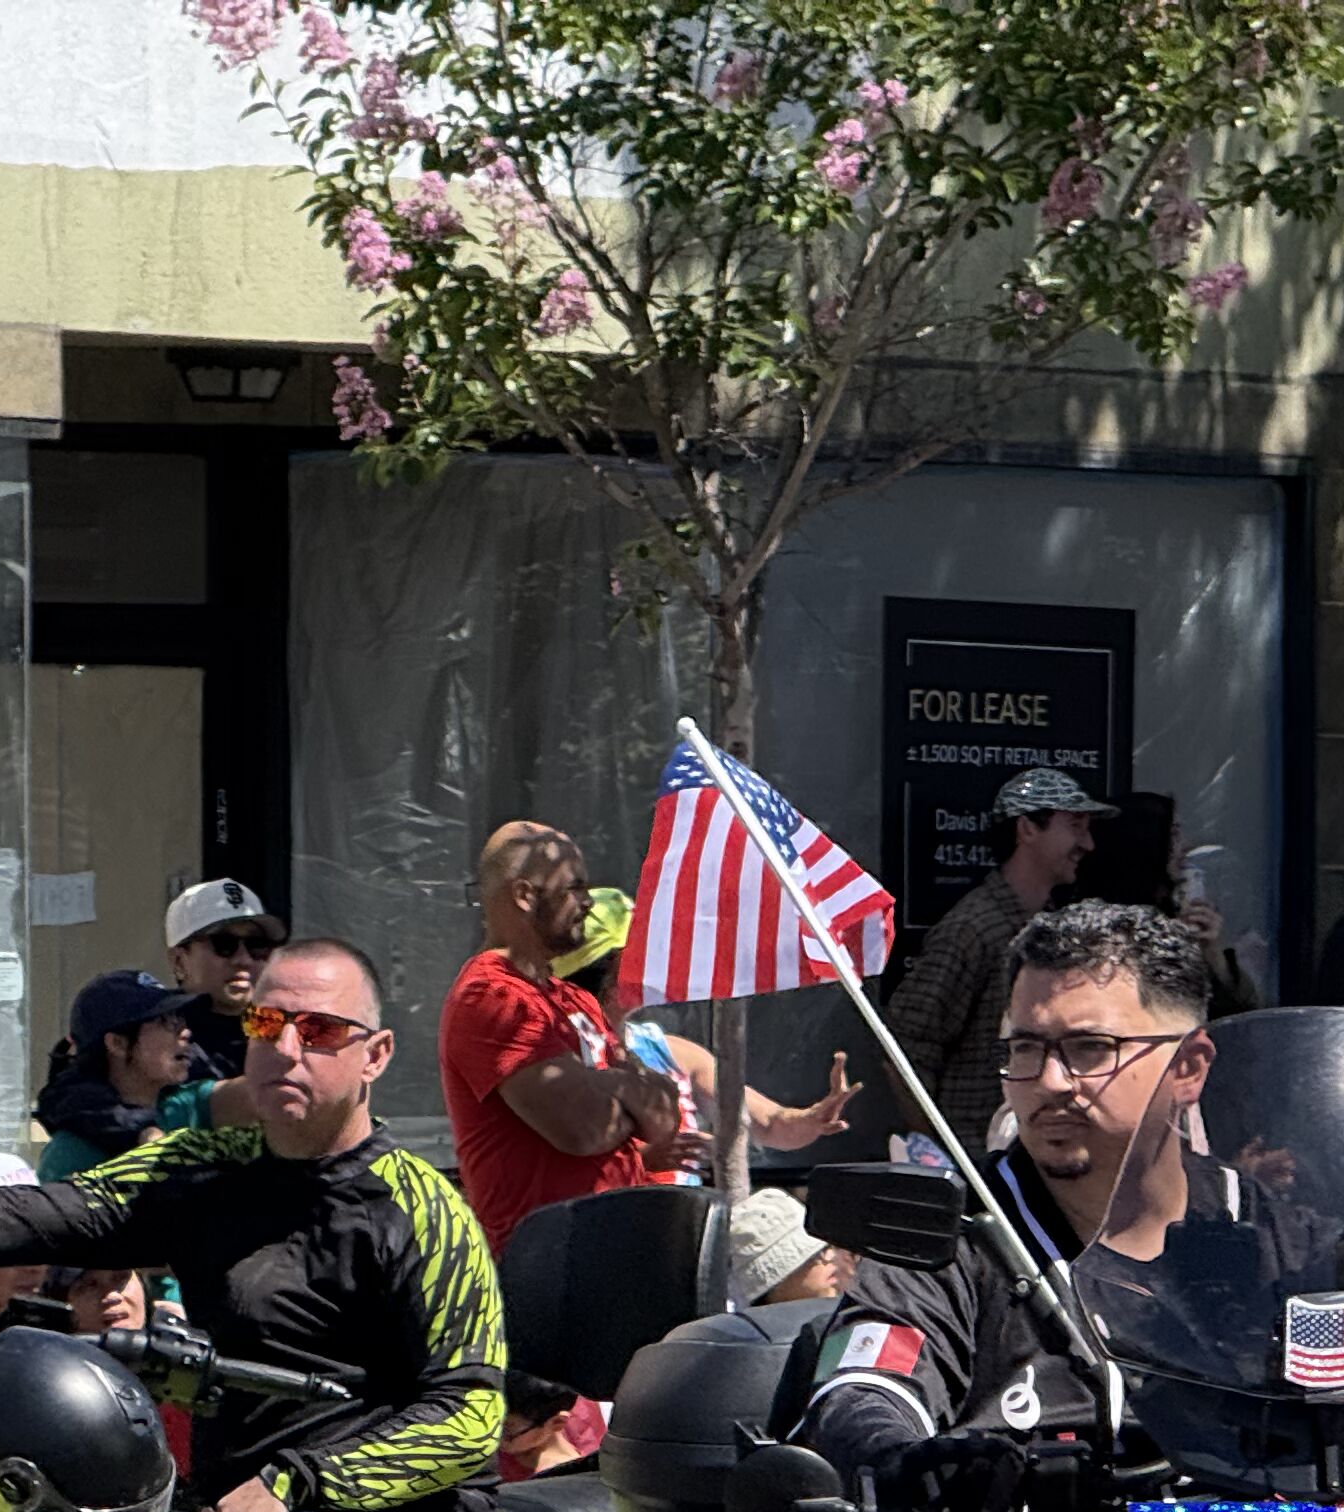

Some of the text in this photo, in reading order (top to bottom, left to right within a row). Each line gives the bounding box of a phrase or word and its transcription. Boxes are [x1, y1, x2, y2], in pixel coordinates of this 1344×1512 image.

[908, 689, 1051, 727] FOR LEASE
[960, 745, 983, 767] SQ
[984, 746, 1003, 765] FT
[1004, 747, 1054, 768] RETAIL
[1054, 750, 1100, 769] SPACE
[935, 808, 976, 832] Davis
